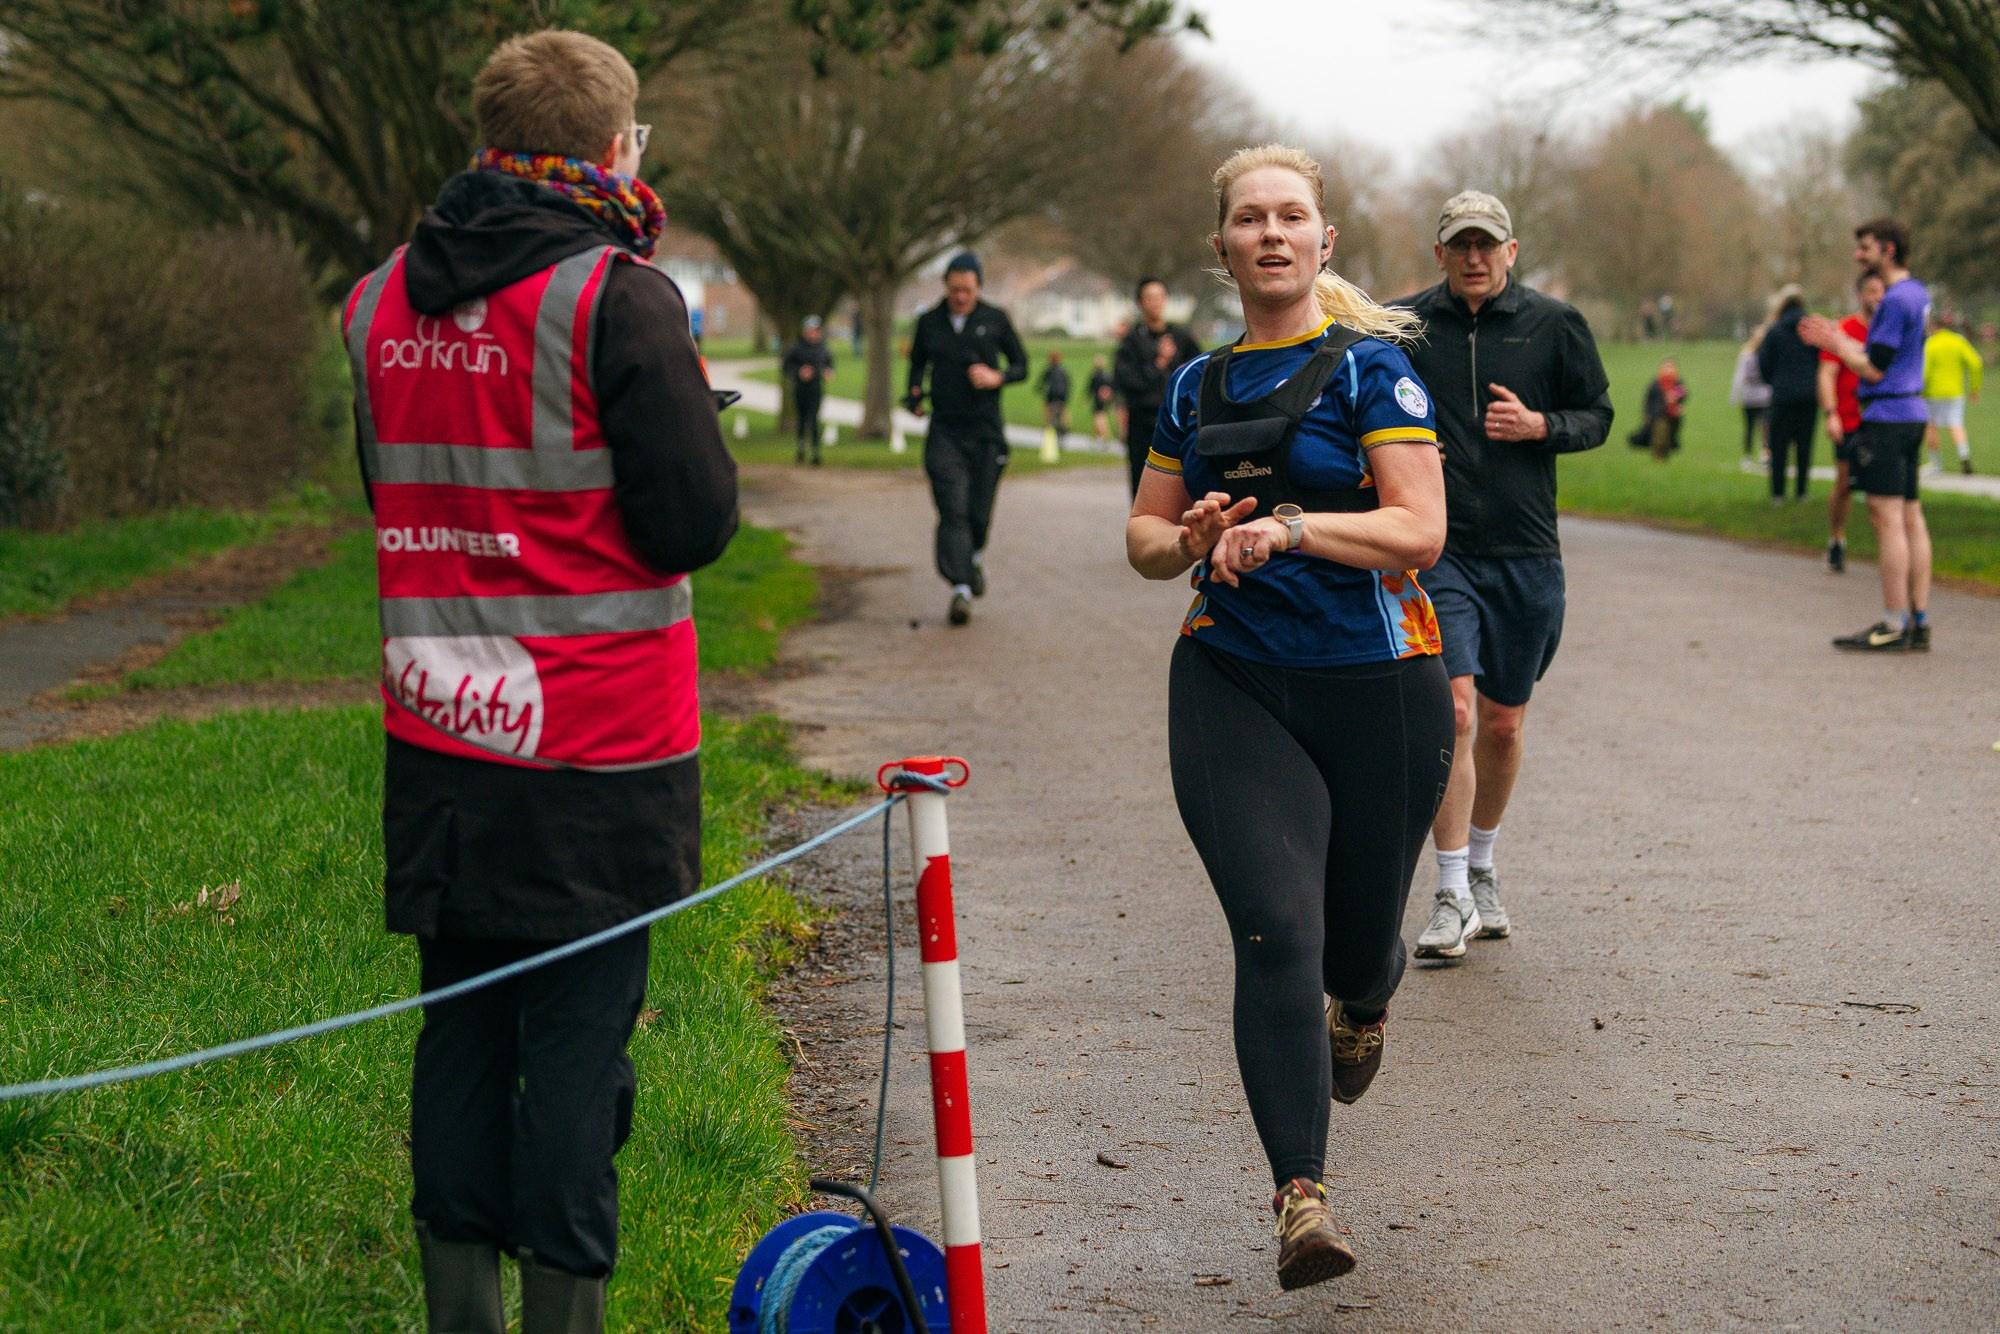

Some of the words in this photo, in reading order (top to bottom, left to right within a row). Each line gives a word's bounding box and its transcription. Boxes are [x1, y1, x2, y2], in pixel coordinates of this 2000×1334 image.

[380, 317, 508, 377] parkrun
[1223, 466, 1273, 479] GOBURN
[377, 526, 521, 558] OLUNTEER
